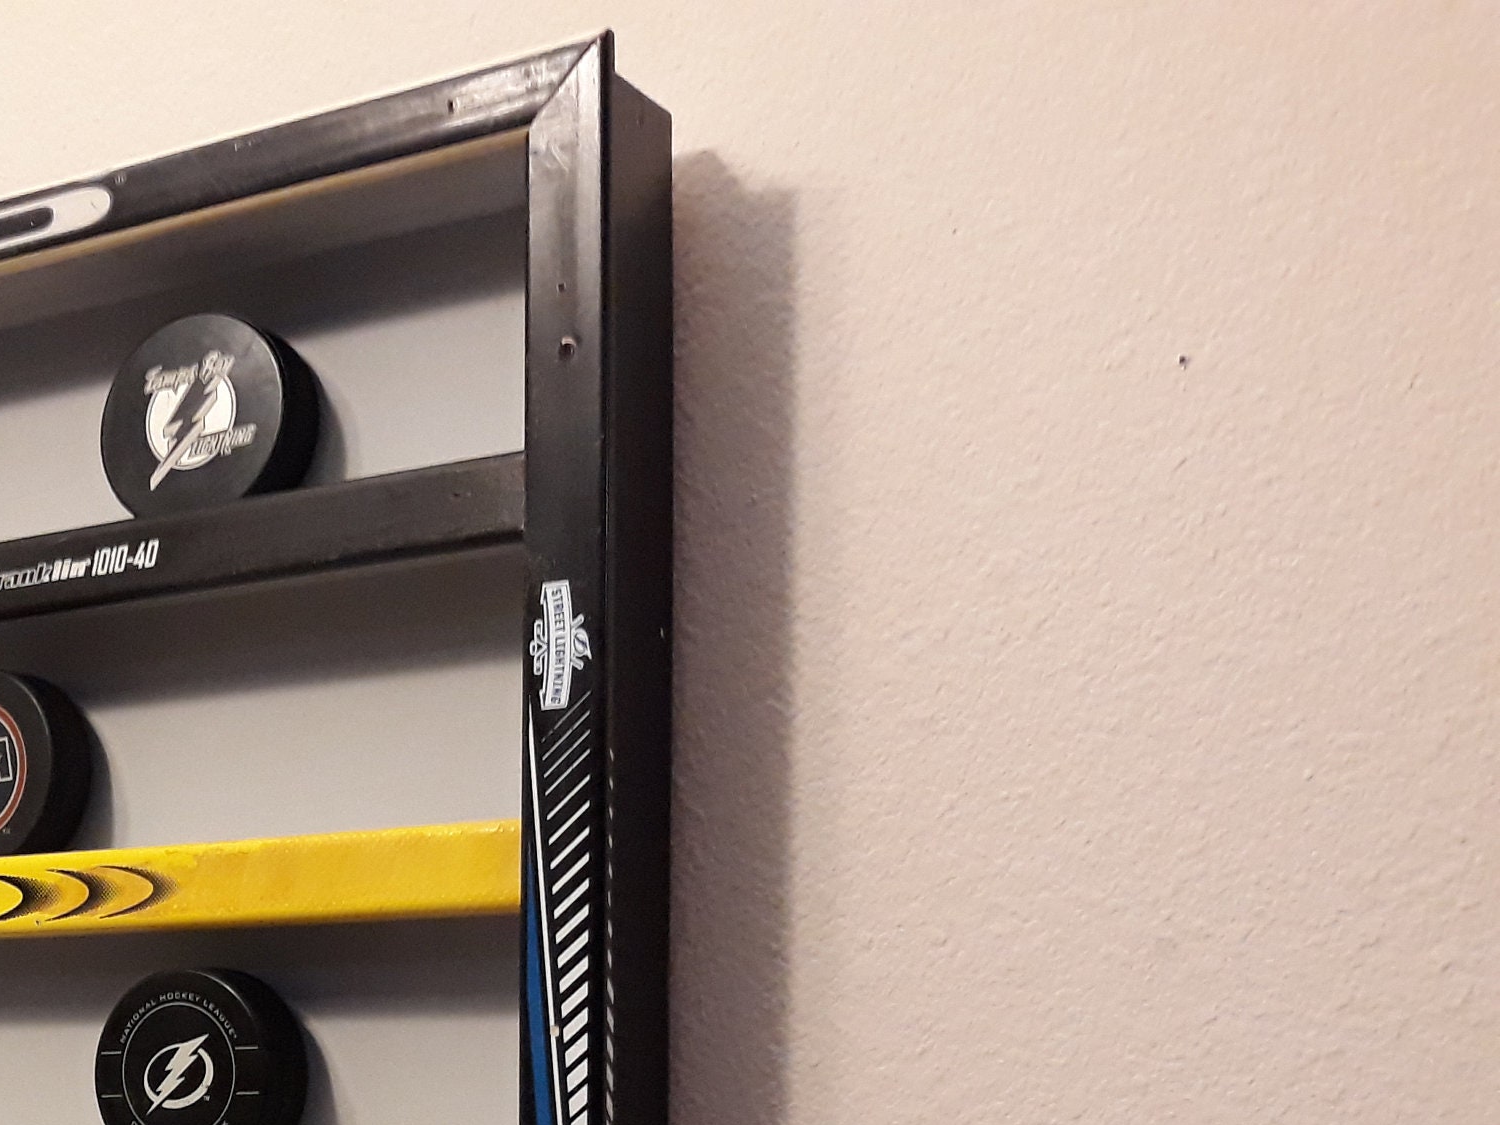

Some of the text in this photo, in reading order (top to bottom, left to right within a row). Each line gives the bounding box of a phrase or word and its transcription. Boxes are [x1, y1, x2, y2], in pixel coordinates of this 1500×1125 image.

[91, 538, 160, 577] 1010-40
[551, 588, 566, 633] STREET
[118, 999, 157, 1044] NATIONAL
[159, 992, 201, 1002] HOCKEY
